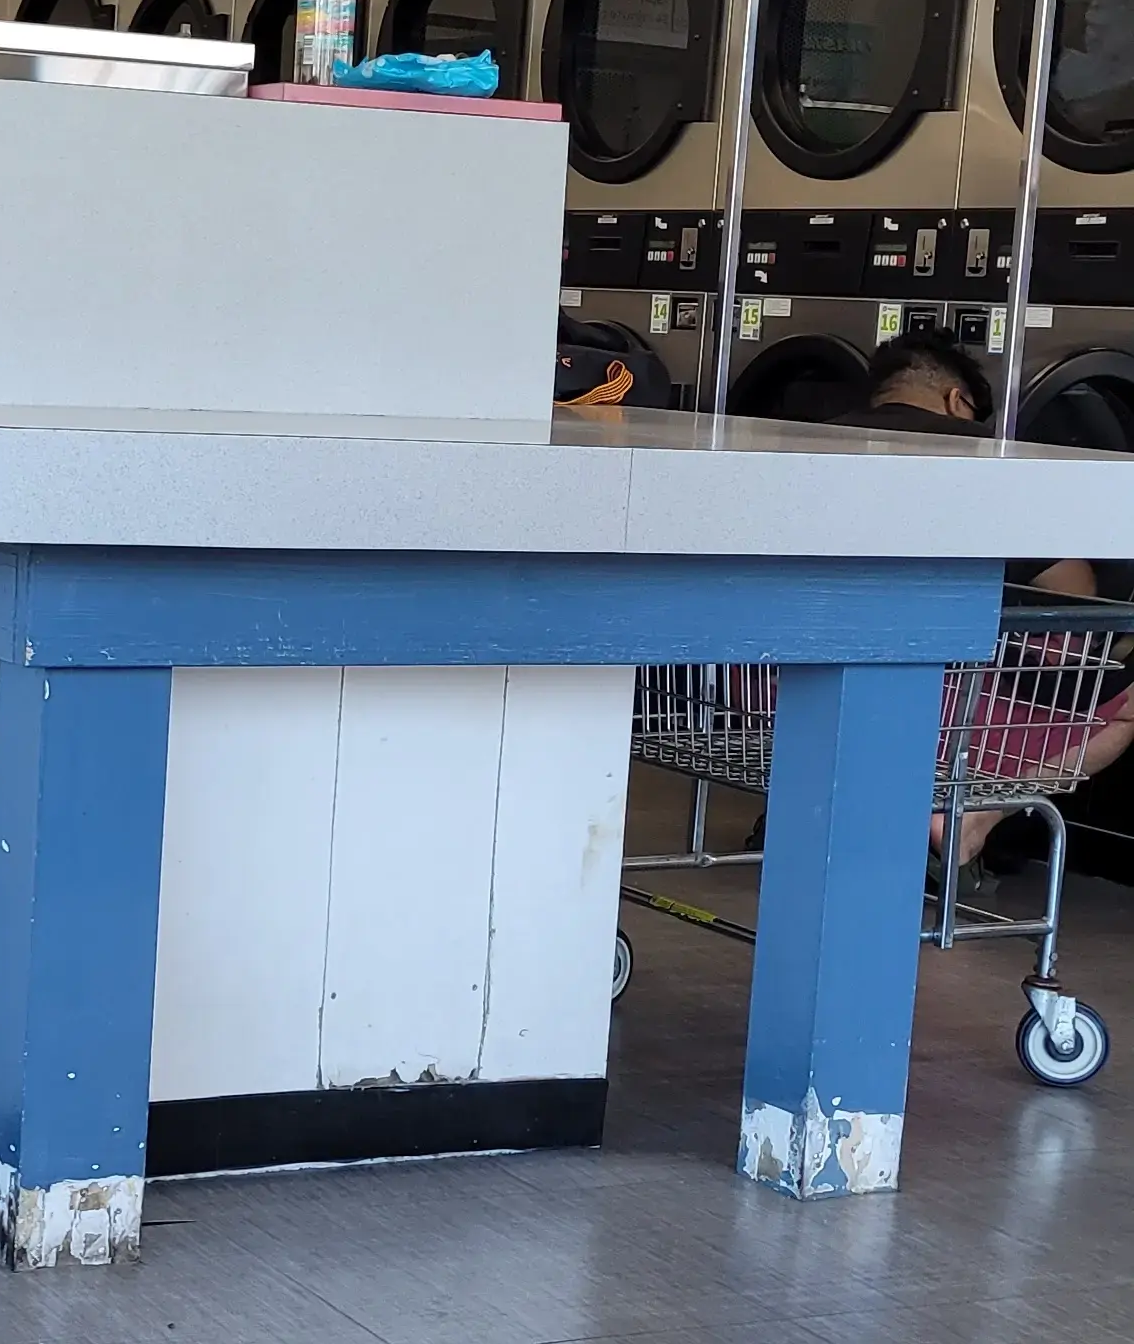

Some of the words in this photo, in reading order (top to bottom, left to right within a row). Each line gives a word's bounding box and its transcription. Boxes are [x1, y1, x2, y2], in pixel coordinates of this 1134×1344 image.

[653, 303, 668, 320] 14
[742, 308, 759, 325] 15
[880, 313, 899, 332] 16
[992, 318, 1006, 337] 1
